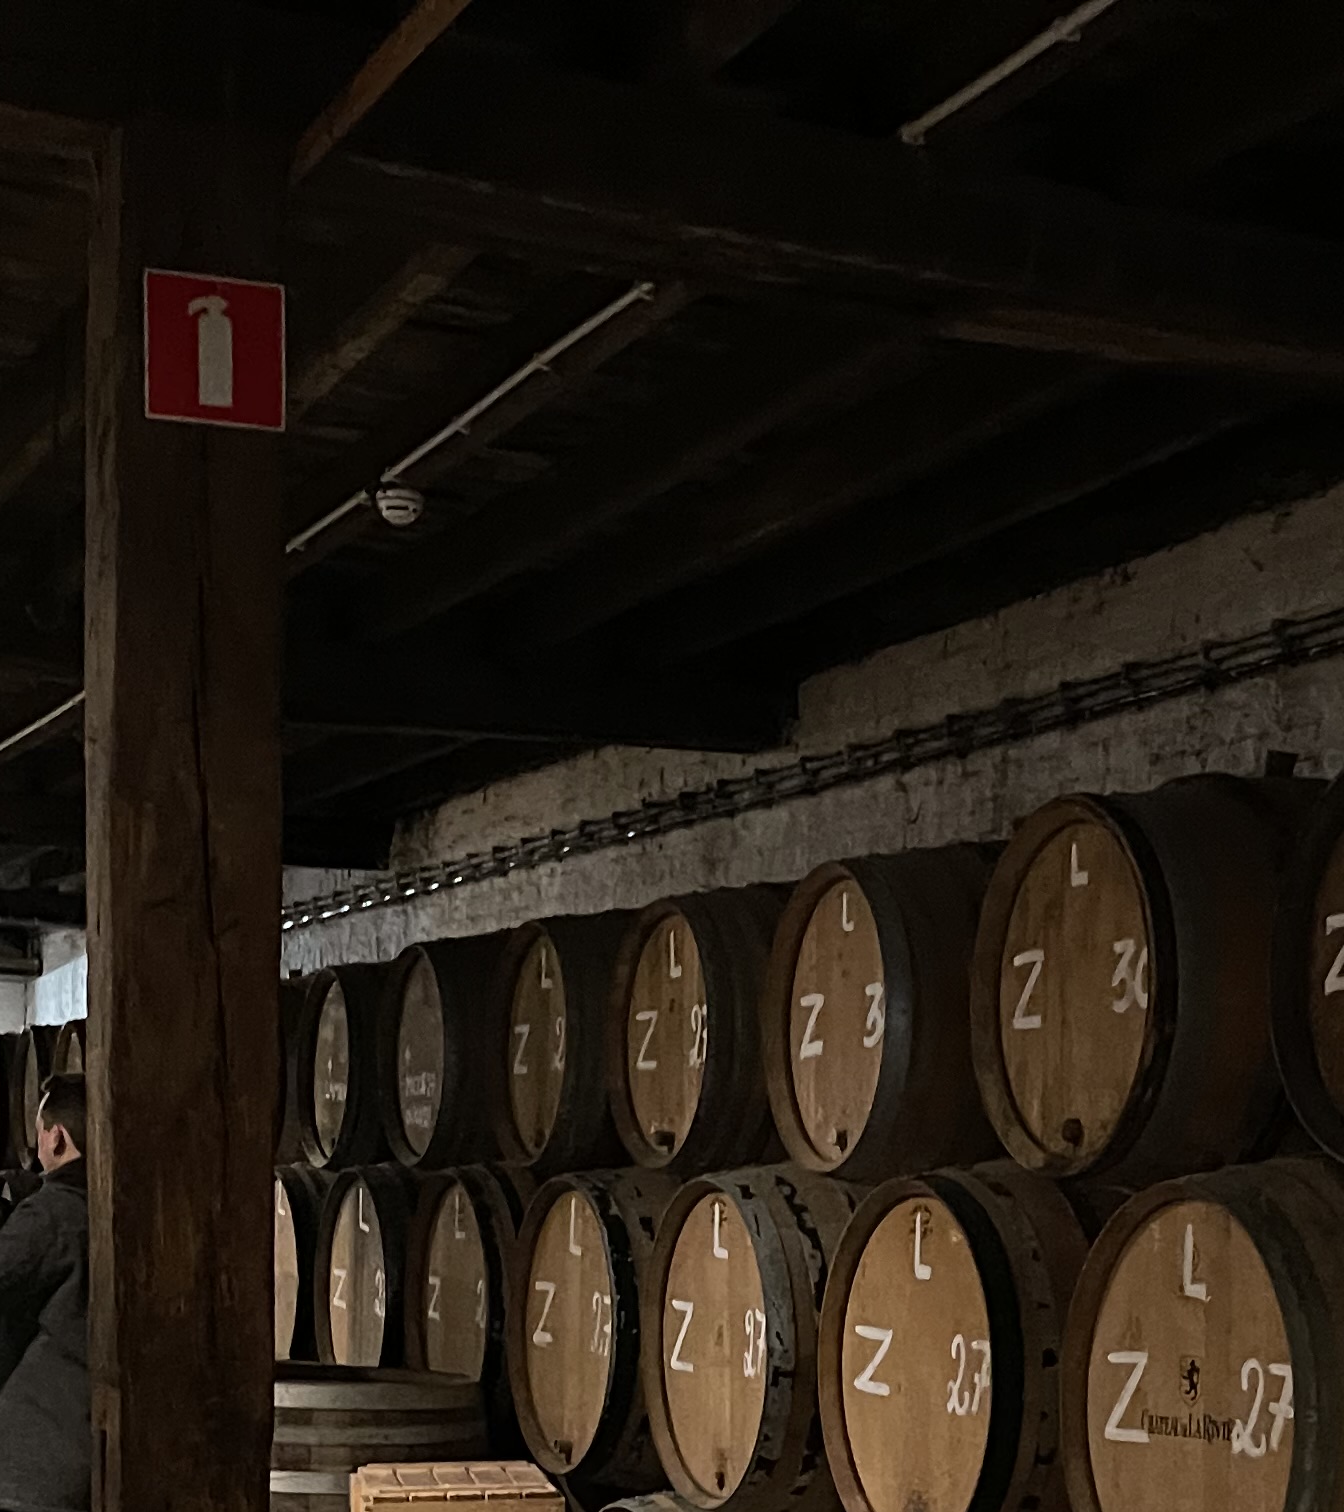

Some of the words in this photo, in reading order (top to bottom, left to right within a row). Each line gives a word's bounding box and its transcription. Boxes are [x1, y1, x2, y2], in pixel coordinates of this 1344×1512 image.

[1070, 842, 1088, 887] L
[842, 892, 854, 931] L
[541, 948, 553, 988] L
[669, 930, 681, 978] L
[1013, 950, 1044, 1029] Z
[514, 1024, 530, 1074] Z
[635, 1010, 658, 1070] Z
[799, 993, 824, 1059] Z
[358, 1187, 370, 1233] L
[455, 1193, 466, 1239] L
[569, 1197, 582, 1256] L
[713, 1201, 729, 1260] L
[914, 1211, 932, 1281] L
[1182, 1223, 1211, 1303] L
[333, 1268, 347, 1310] Z
[428, 1275, 441, 1321] Z
[533, 1281, 556, 1347] Z
[670, 1299, 694, 1373] Z
[744, 1308, 766, 1378] 27
[854, 1325, 894, 1396] Z
[947, 1333, 992, 1417] 27
[1104, 1351, 1151, 1443] Z
[1230, 1357, 1295, 1458] 27
